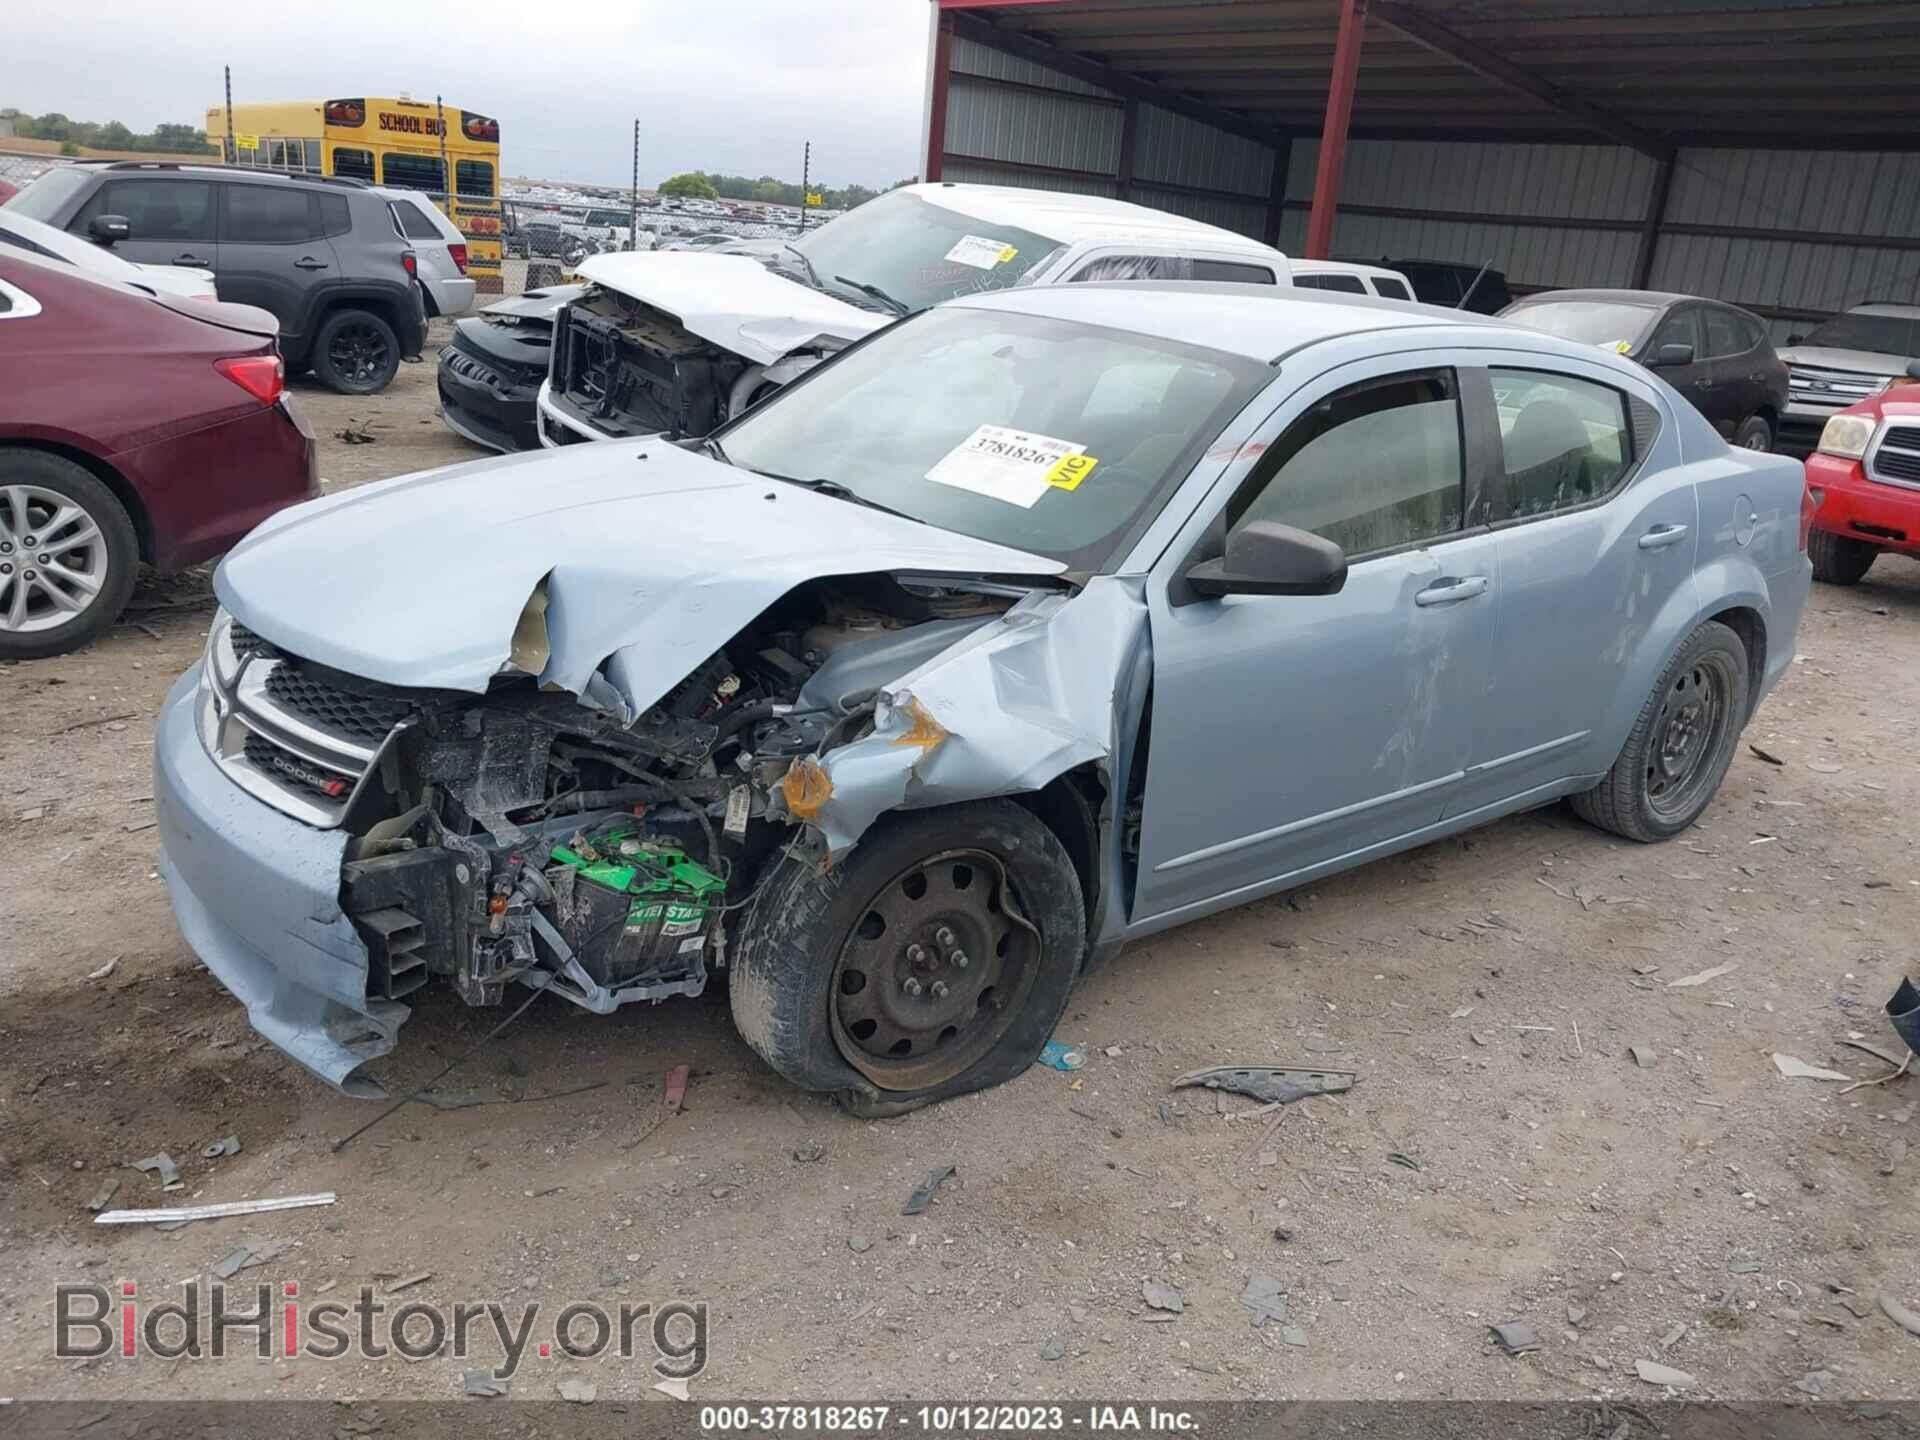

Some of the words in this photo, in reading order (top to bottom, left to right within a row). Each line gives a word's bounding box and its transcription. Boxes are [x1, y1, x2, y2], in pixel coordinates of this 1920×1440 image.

[379, 112, 423, 134] SCHOOL
[425, 118, 447, 136] BUS
[972, 438, 1060, 466] 37818267
[1051, 456, 1087, 484] VIC
[274, 757, 327, 786] DODGE
